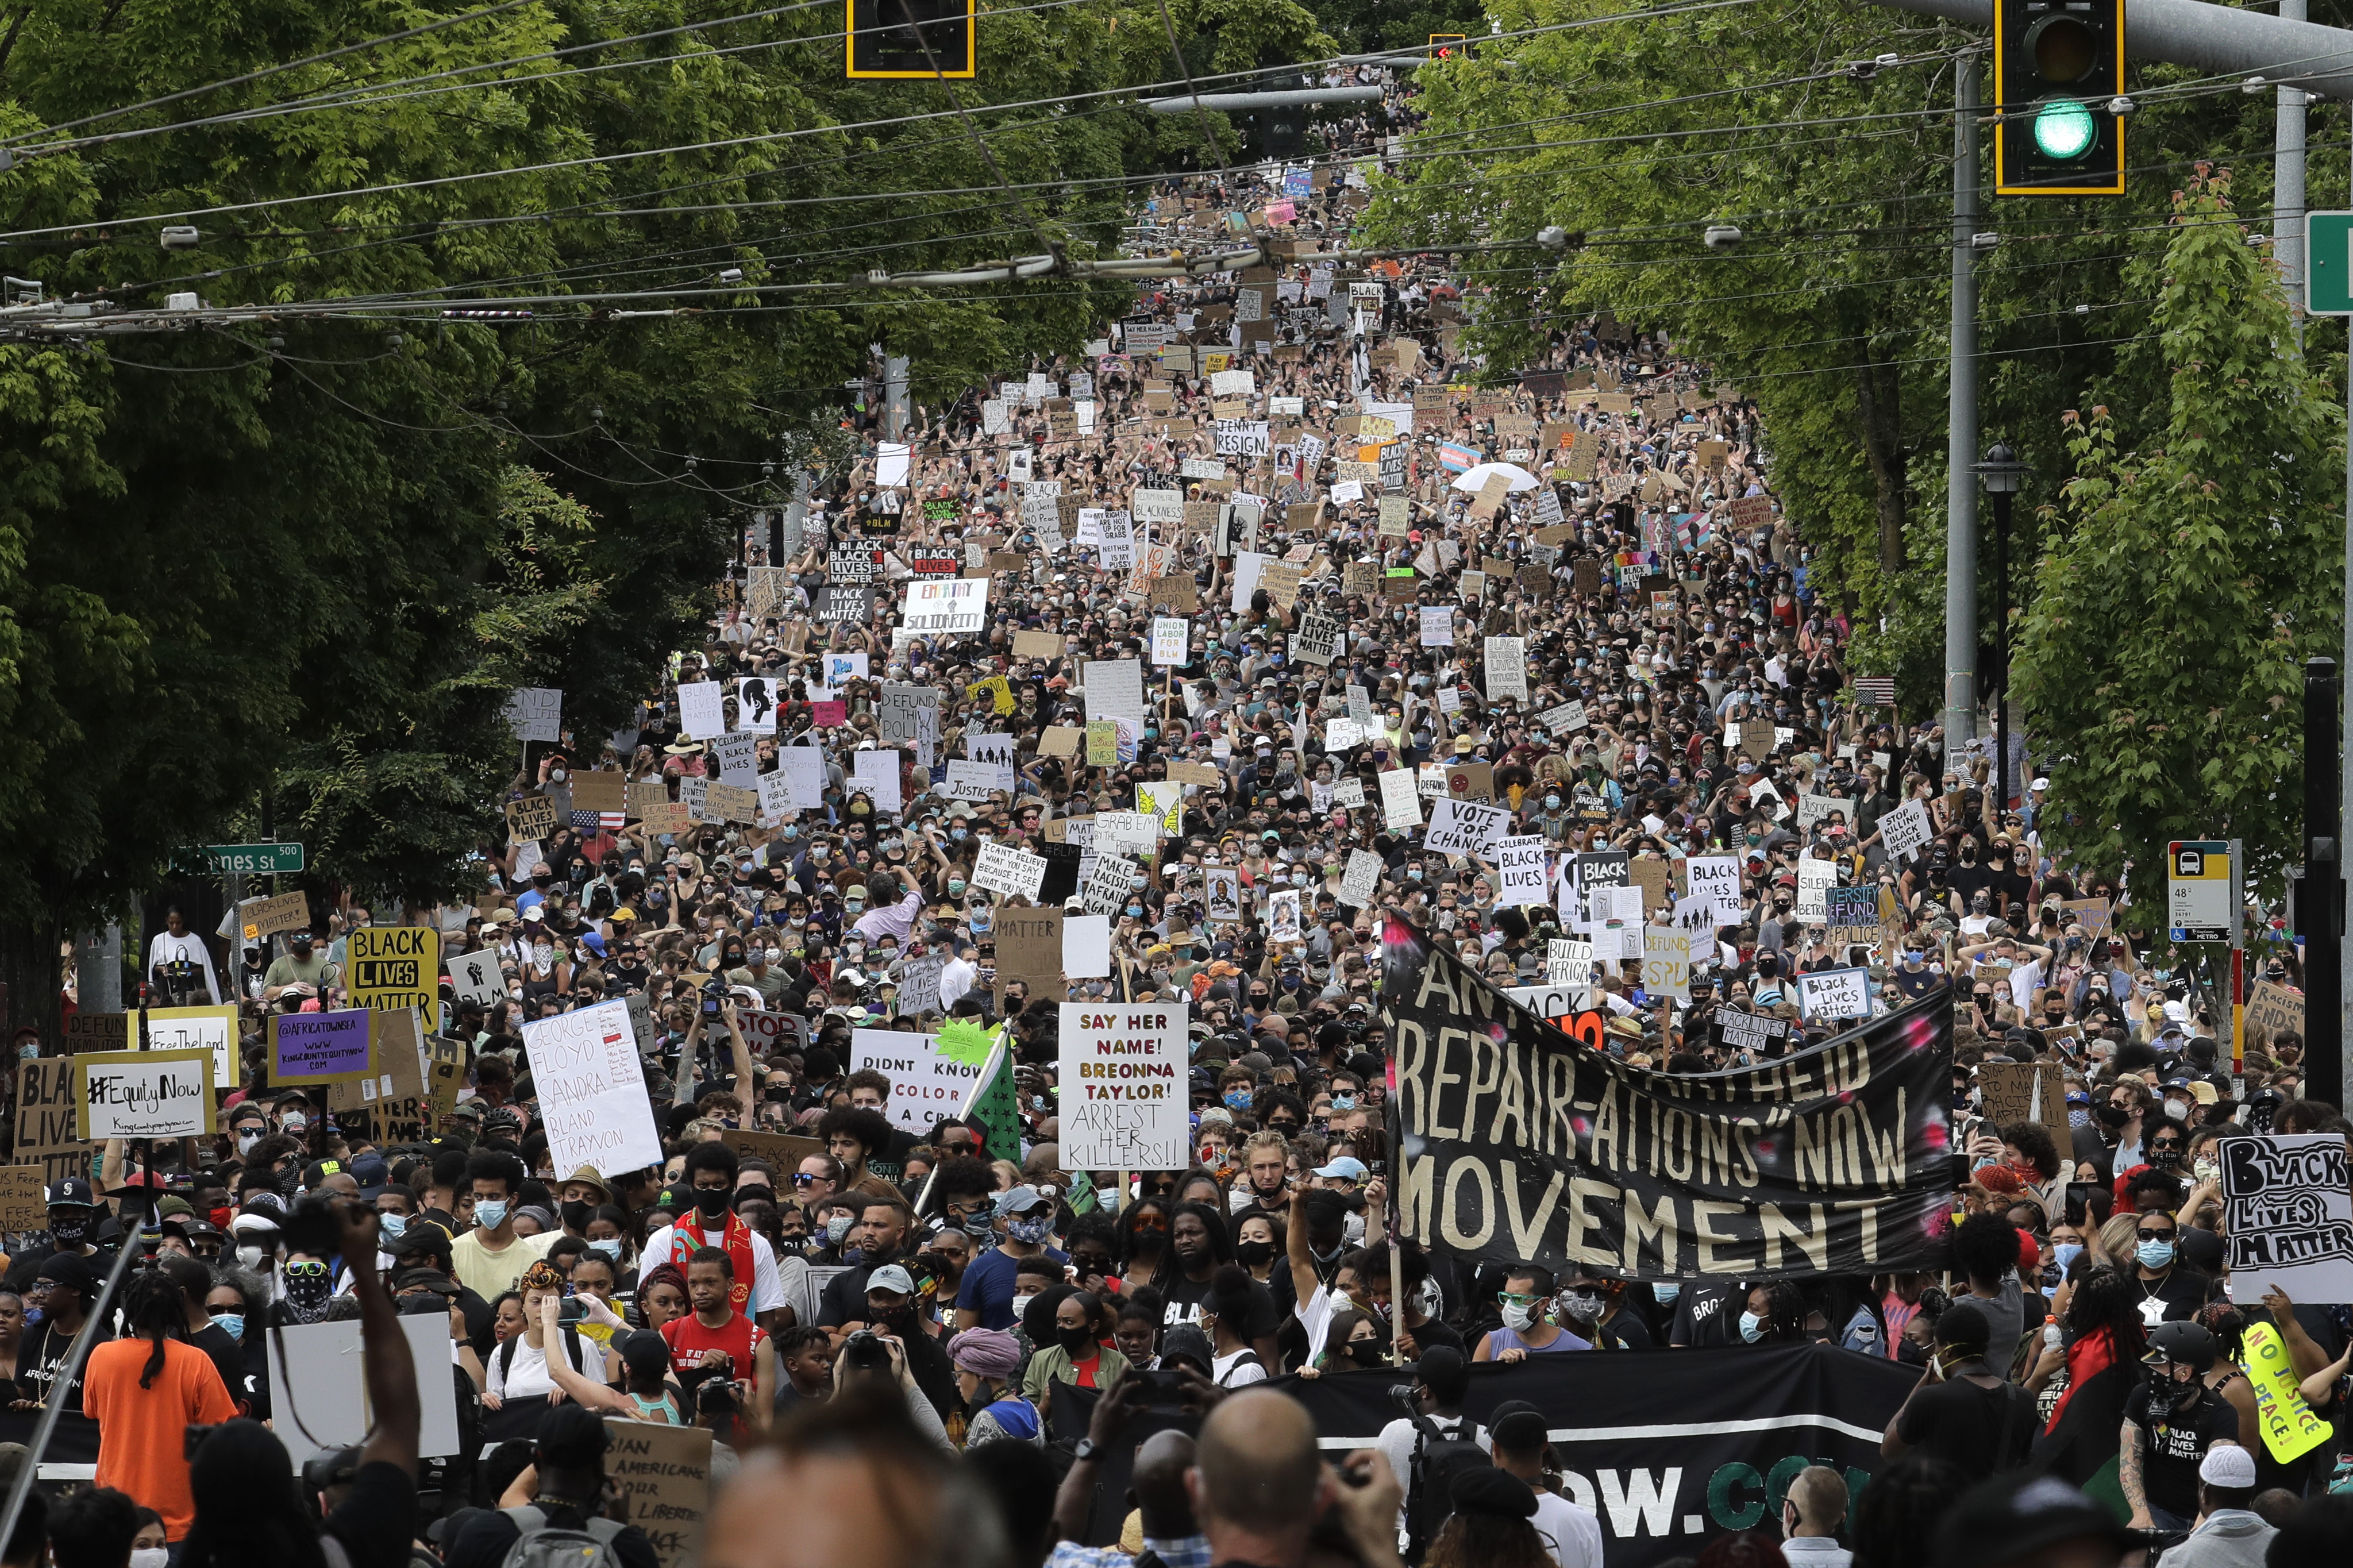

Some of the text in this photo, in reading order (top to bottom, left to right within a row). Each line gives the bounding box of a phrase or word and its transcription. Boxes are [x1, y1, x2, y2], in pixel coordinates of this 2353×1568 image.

[1217, 419, 1258, 433] JENNY
[1184, 461, 1222, 471] DEFUND
[1190, 469, 1210, 477] SPD
[1147, 473, 1181, 483] BLACK
[1135, 506, 1183, 518] BLACKNESS
[829, 551, 871, 561] BLACK
[832, 563, 871, 574] LIVES
[831, 575, 873, 584] MATTER
[830, 590, 864, 600] BLACK
[922, 583, 973, 599] EMPATHY
[830, 600, 865, 610] LIVES
[819, 610, 864, 621] MATTER
[907, 613, 980, 630] SOLIDARITY
[1305, 617, 1339, 631] BLACK
[1157, 621, 1184, 629] UNION
[1157, 630, 1184, 638] LABOR
[1301, 630, 1337, 644] LIVES
[1160, 639, 1179, 647] FOR
[1298, 641, 1334, 657] MATTER
[1160, 650, 1178, 658] BLM
[685, 685, 717, 698] BLACK
[687, 696, 718, 710] LIVES
[686, 710, 718, 721] MATTER
[718, 733, 753, 746] CELEBRATE
[725, 748, 752, 758] BLACK
[723, 760, 749, 770] LIVES
[950, 780, 995, 798] JUSTICE
[515, 796, 553, 814] BLACK
[1800, 798, 1832, 815] JUSTICE
[521, 811, 553, 825] LIVES
[1095, 813, 1133, 829] GRAB
[1451, 803, 1501, 826] VOTE
[1886, 807, 1909, 825] STOP
[1455, 822, 1488, 838] FOR
[1884, 812, 1920, 837] KILLING
[1095, 831, 1116, 841] BY THE
[1889, 824, 1919, 843] BLACK
[280, 846, 296, 856] 500
[1045, 844, 1080, 857] #BLM
[1430, 830, 1497, 856] CHANGE
[1499, 837, 1542, 849] CELEBRATE
[1890, 831, 1922, 854] PEOPLE
[260, 855, 275, 869] St
[985, 854, 1039, 874] WHAT YOU SAY
[1016, 853, 1046, 868] BELIEVE
[1098, 856, 1134, 878] MAKE
[1501, 850, 1543, 868] BLACK
[978, 864, 1011, 879] BECAUSE
[1022, 876, 1038, 887] SEE
[1093, 869, 1131, 889] RACISTS
[1504, 870, 1542, 887] LIVES
[1584, 862, 1627, 881] BLACK
[1693, 864, 1738, 881] BLACK
[976, 874, 999, 888] WHAT
[1000, 883, 1014, 894] YOU
[1800, 877, 1836, 889] SILENCE
[1088, 883, 1126, 904] AFRAID
[1814, 892, 1823, 901] IS
[1827, 887, 1878, 903] DIVERSIFY
[2175, 888, 2186, 897] 48
[245, 895, 301, 918] BLACK LIVES
[1827, 903, 1874, 917] DEFUND
[257, 909, 300, 930] MATTER!
[998, 920, 1054, 938] MATTER
[1836, 926, 1878, 943] POLICE
[354, 930, 425, 957] BLACK
[1549, 940, 1592, 960] BUILD
[1646, 935, 1689, 952] DEFUND
[359, 962, 415, 987] LIVES
[904, 957, 946, 978] BLACK
[1549, 961, 1588, 982] AFRICA
[1649, 961, 1688, 987] SPD
[910, 971, 939, 988] LIVES
[902, 986, 940, 1009] MATTER
[1821, 989, 1859, 1004] Lives
[2257, 986, 2305, 1016] Racism
[353, 992, 432, 1026] MATTER
[2249, 1004, 2297, 1031] ENDS
[279, 1019, 356, 1038] @AFRICATOWNSEA
[526, 1011, 594, 1050] GEORGE
[1080, 1015, 1167, 1029] SAY HER
[1716, 1010, 1785, 1035] BLACK LIVES
[925, 1039, 928, 1050] I
[1097, 1038, 1162, 1054] NAME!
[1724, 1027, 1766, 1049] MATTER
[282, 1047, 365, 1064] KINGCOUNTYEQUITYNOW
[533, 1039, 594, 1077] FLOYD
[863, 1057, 915, 1072] DIDNT
[1080, 1063, 1174, 1078] BREONNA
[21, 1062, 75, 1107] BLA
[895, 1084, 959, 1101] COLOR
[1085, 1082, 1171, 1100] TAYLOR!
[539, 1073, 607, 1115] SANDRA
[901, 1109, 912, 1120] A
[1070, 1104, 1162, 1131] ARREST
[18, 1110, 90, 1147] LIVE
[549, 1109, 595, 1139] BLAND
[553, 1128, 623, 1160] TRAYVON
[1099, 1130, 1144, 1148] HER
[1794, 1086, 1907, 1192] NOW
[1069, 1139, 1177, 1166] KILLERS!!
[15, 1151, 91, 1188] TTER
[321, 1161, 338, 1171] MAD
[2231, 1141, 2349, 1195] BLACK
[1398, 1145, 1897, 1277] MOVEMENT
[2239, 1230, 2352, 1265] MATTER
[2247, 1330, 2278, 1360] NO
[2252, 1382, 2294, 1446] PEACE!
[615, 1459, 705, 1480] AMERICANS
